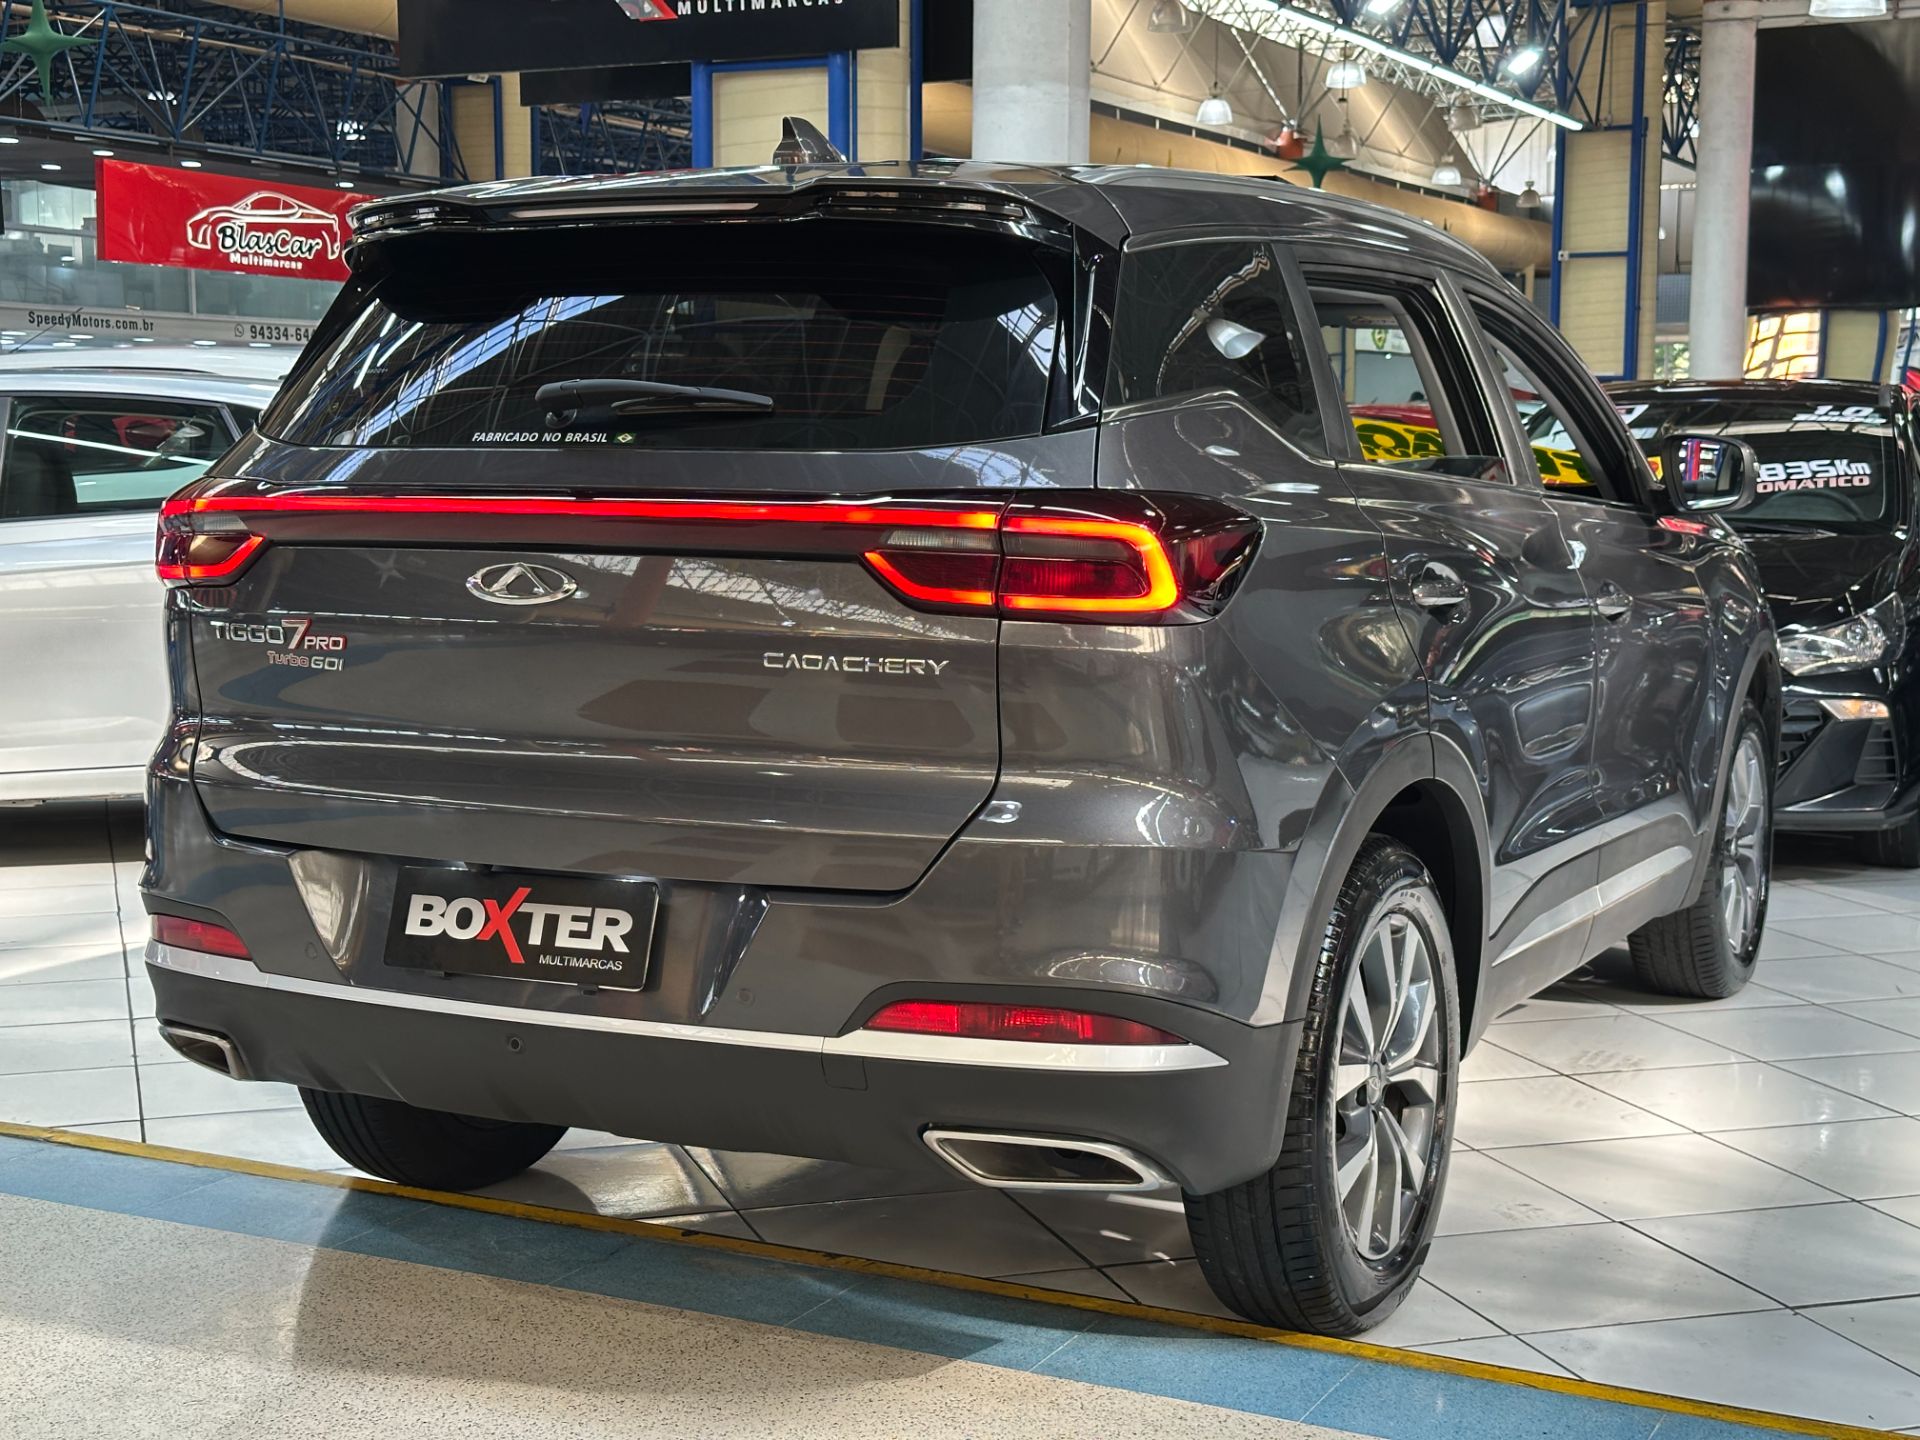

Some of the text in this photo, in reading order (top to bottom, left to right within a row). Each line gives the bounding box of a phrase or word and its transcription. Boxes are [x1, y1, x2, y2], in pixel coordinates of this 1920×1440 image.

[677, 0, 843, 15] MULTIMAR
[216, 222, 322, 259] BlasCar
[229, 252, 302, 270] Multimarcas
[28, 311, 154, 332] SpeedyMotors.com.br
[471, 432, 608, 443] FABRICADO NO BRASIL
[405, 887, 633, 964] BOXTER
[538, 954, 623, 971] MULTIMARCAS
